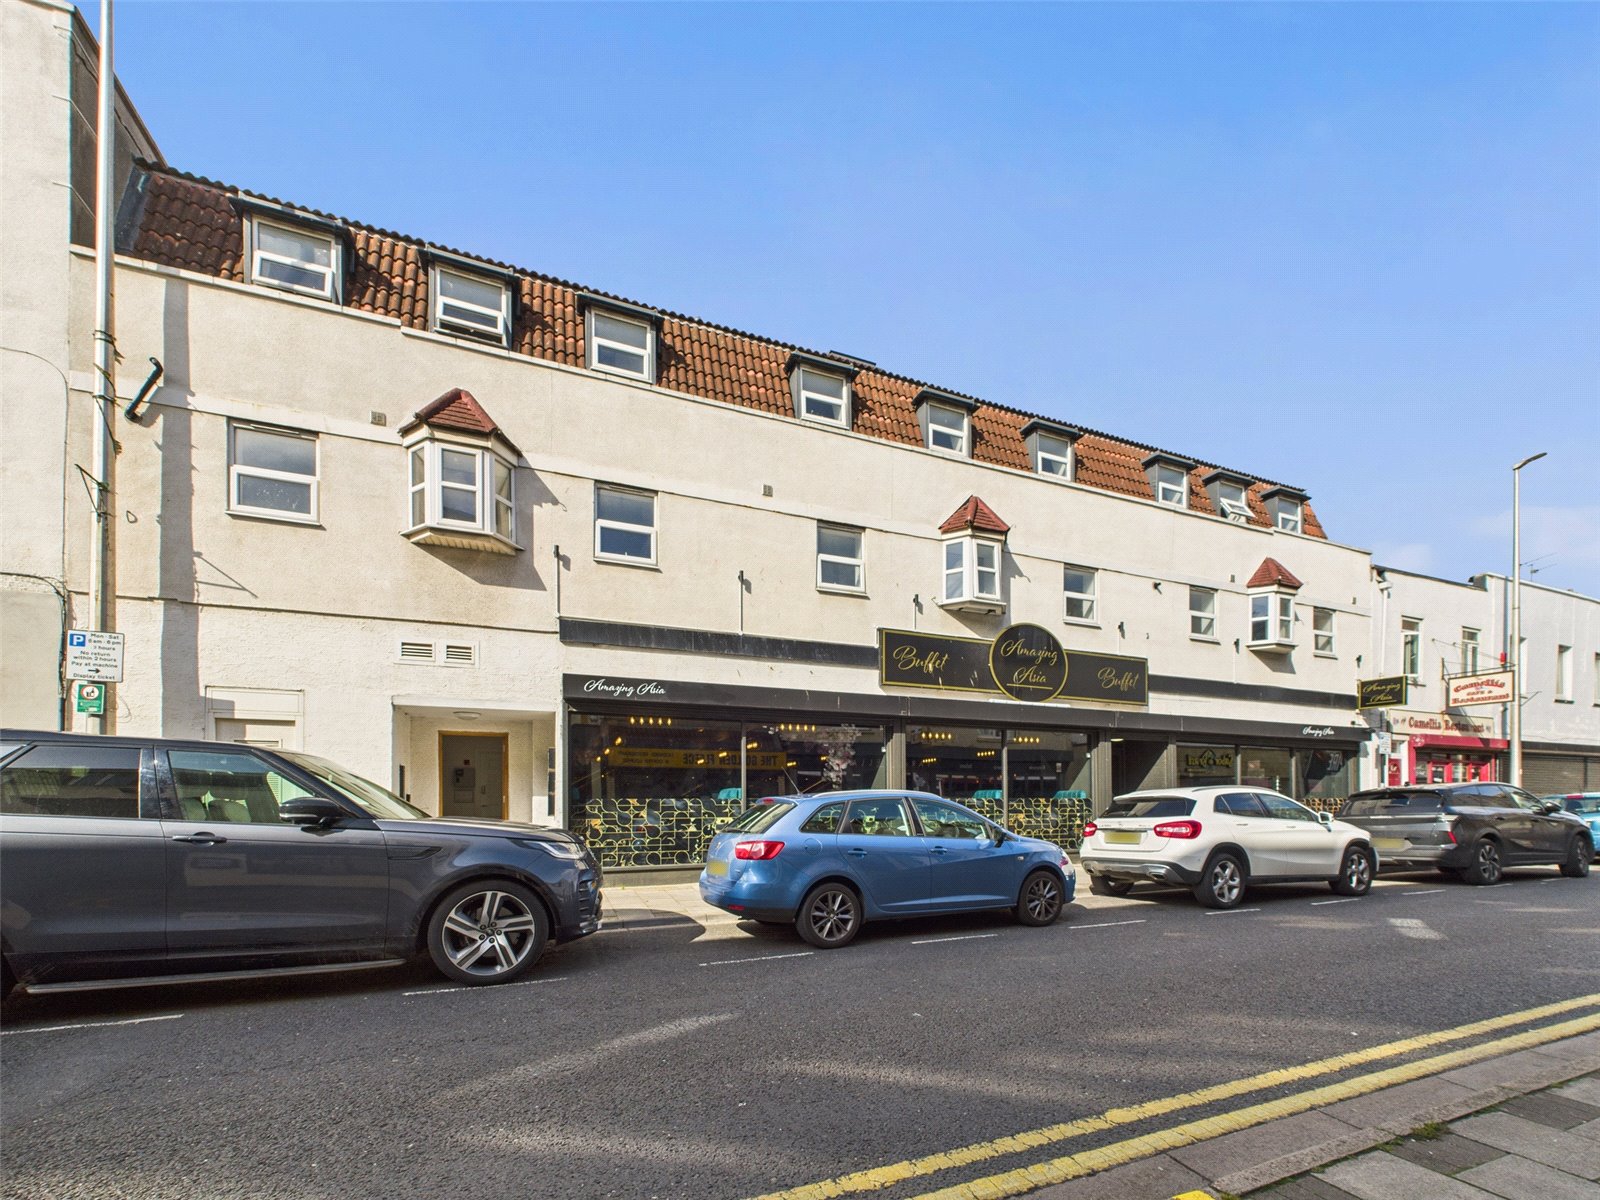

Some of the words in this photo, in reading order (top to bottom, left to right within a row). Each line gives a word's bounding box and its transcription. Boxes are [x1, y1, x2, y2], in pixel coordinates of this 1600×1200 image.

[73, 635, 84, 646] P
[893, 645, 949, 674] Buffet
[1001, 639, 1057, 666] Amazing
[1013, 665, 1048, 684] Asia
[1097, 667, 1139, 692] Buffet
[583, 678, 635, 697] Amazing
[636, 682, 666, 695] Asia
[1362, 683, 1401, 693] Amazing
[1452, 693, 1510, 704] Restaurant
[1408, 716, 1442, 730] Camellia
